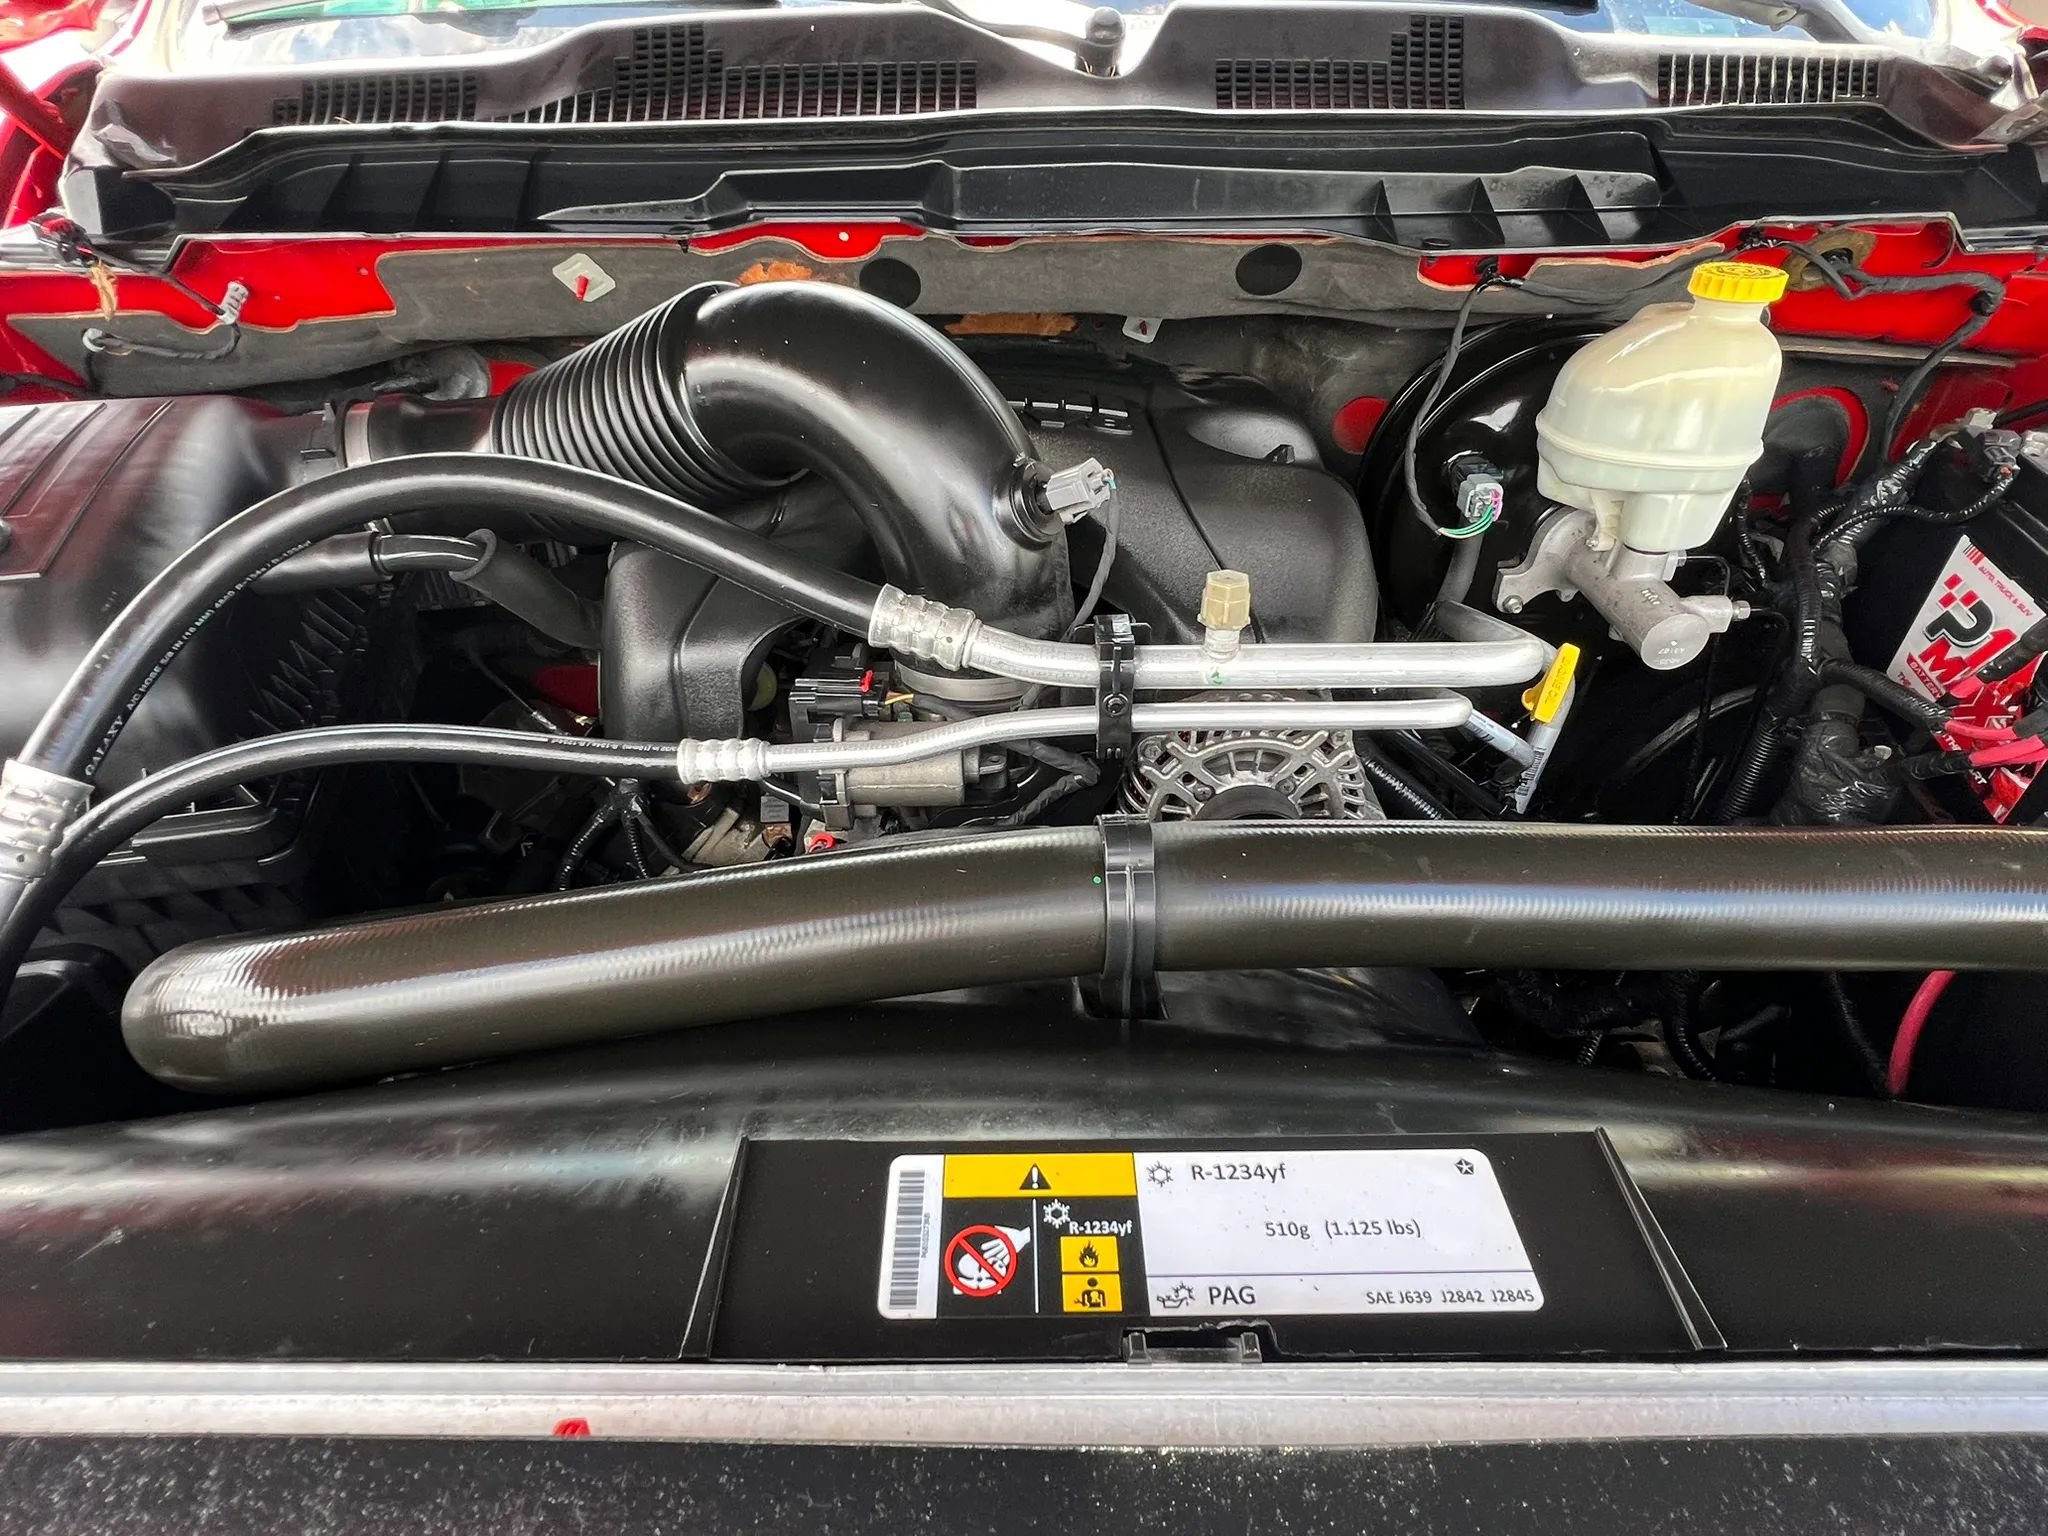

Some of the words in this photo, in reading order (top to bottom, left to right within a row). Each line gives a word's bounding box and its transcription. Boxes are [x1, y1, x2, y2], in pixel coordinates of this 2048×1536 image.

[1994, 580, 2013, 600] TRUCK
[2016, 601, 2033, 617] SUV
[1909, 661, 1942, 699] BATTERY
[84, 714, 123, 776] GALAXY
[126, 692, 141, 711] A/C
[139, 665, 162, 692] HOSE
[1190, 1163, 1288, 1183] R-1234yf
[1069, 1219, 1133, 1237] R-1234yf
[1265, 1221, 1310, 1240] 510g
[1325, 1219, 1383, 1240] (1.125
[1388, 1217, 1421, 1238] lbs)
[1207, 1286, 1256, 1305] PAG
[1366, 1291, 1395, 1304] SAE
[1399, 1290, 1432, 1304] J639
[1441, 1289, 1485, 1304] J2842
[1491, 1289, 1535, 1304] J2845
